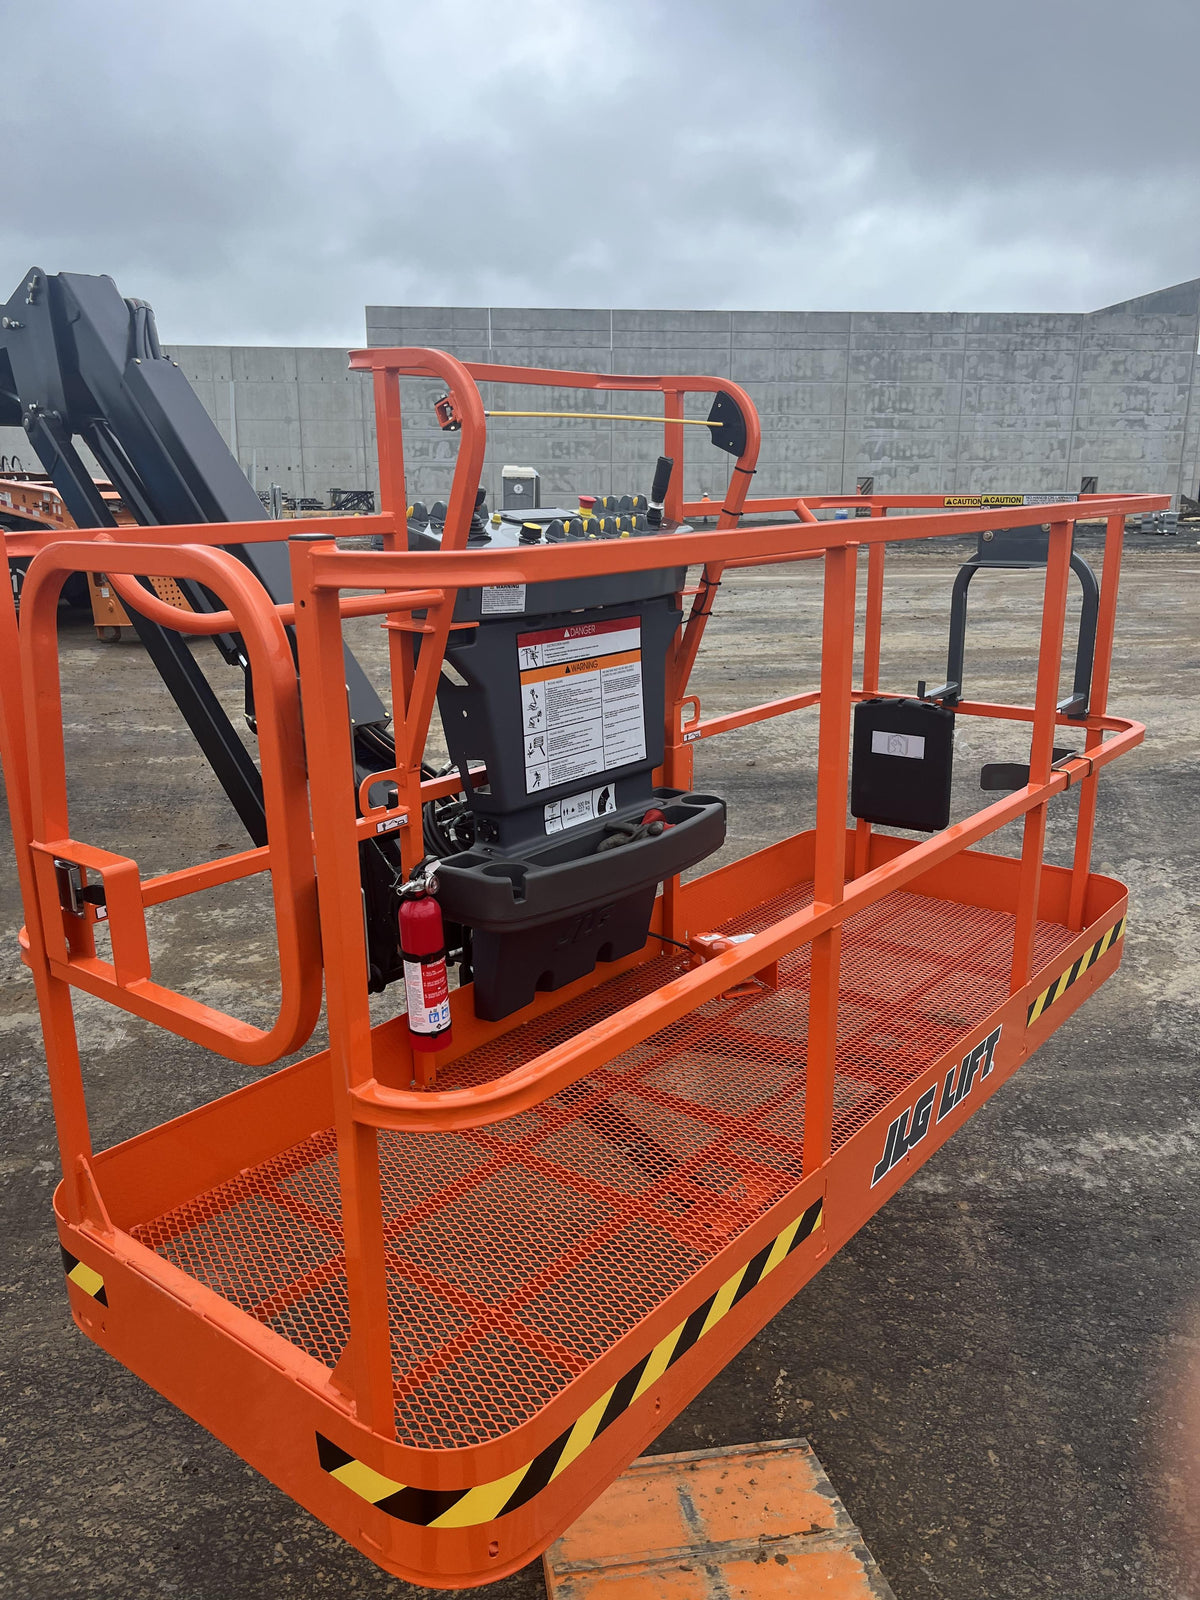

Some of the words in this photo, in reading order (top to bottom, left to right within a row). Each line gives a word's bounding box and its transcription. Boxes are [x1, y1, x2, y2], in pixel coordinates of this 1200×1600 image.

[952, 498, 982, 506] CAUTION
[990, 496, 1022, 504] CAUTION
[570, 624, 596, 637] DANGER
[571, 660, 598, 673] WARNING
[870, 1082, 938, 1189] JLG
[936, 1023, 1003, 1125] LIFT
